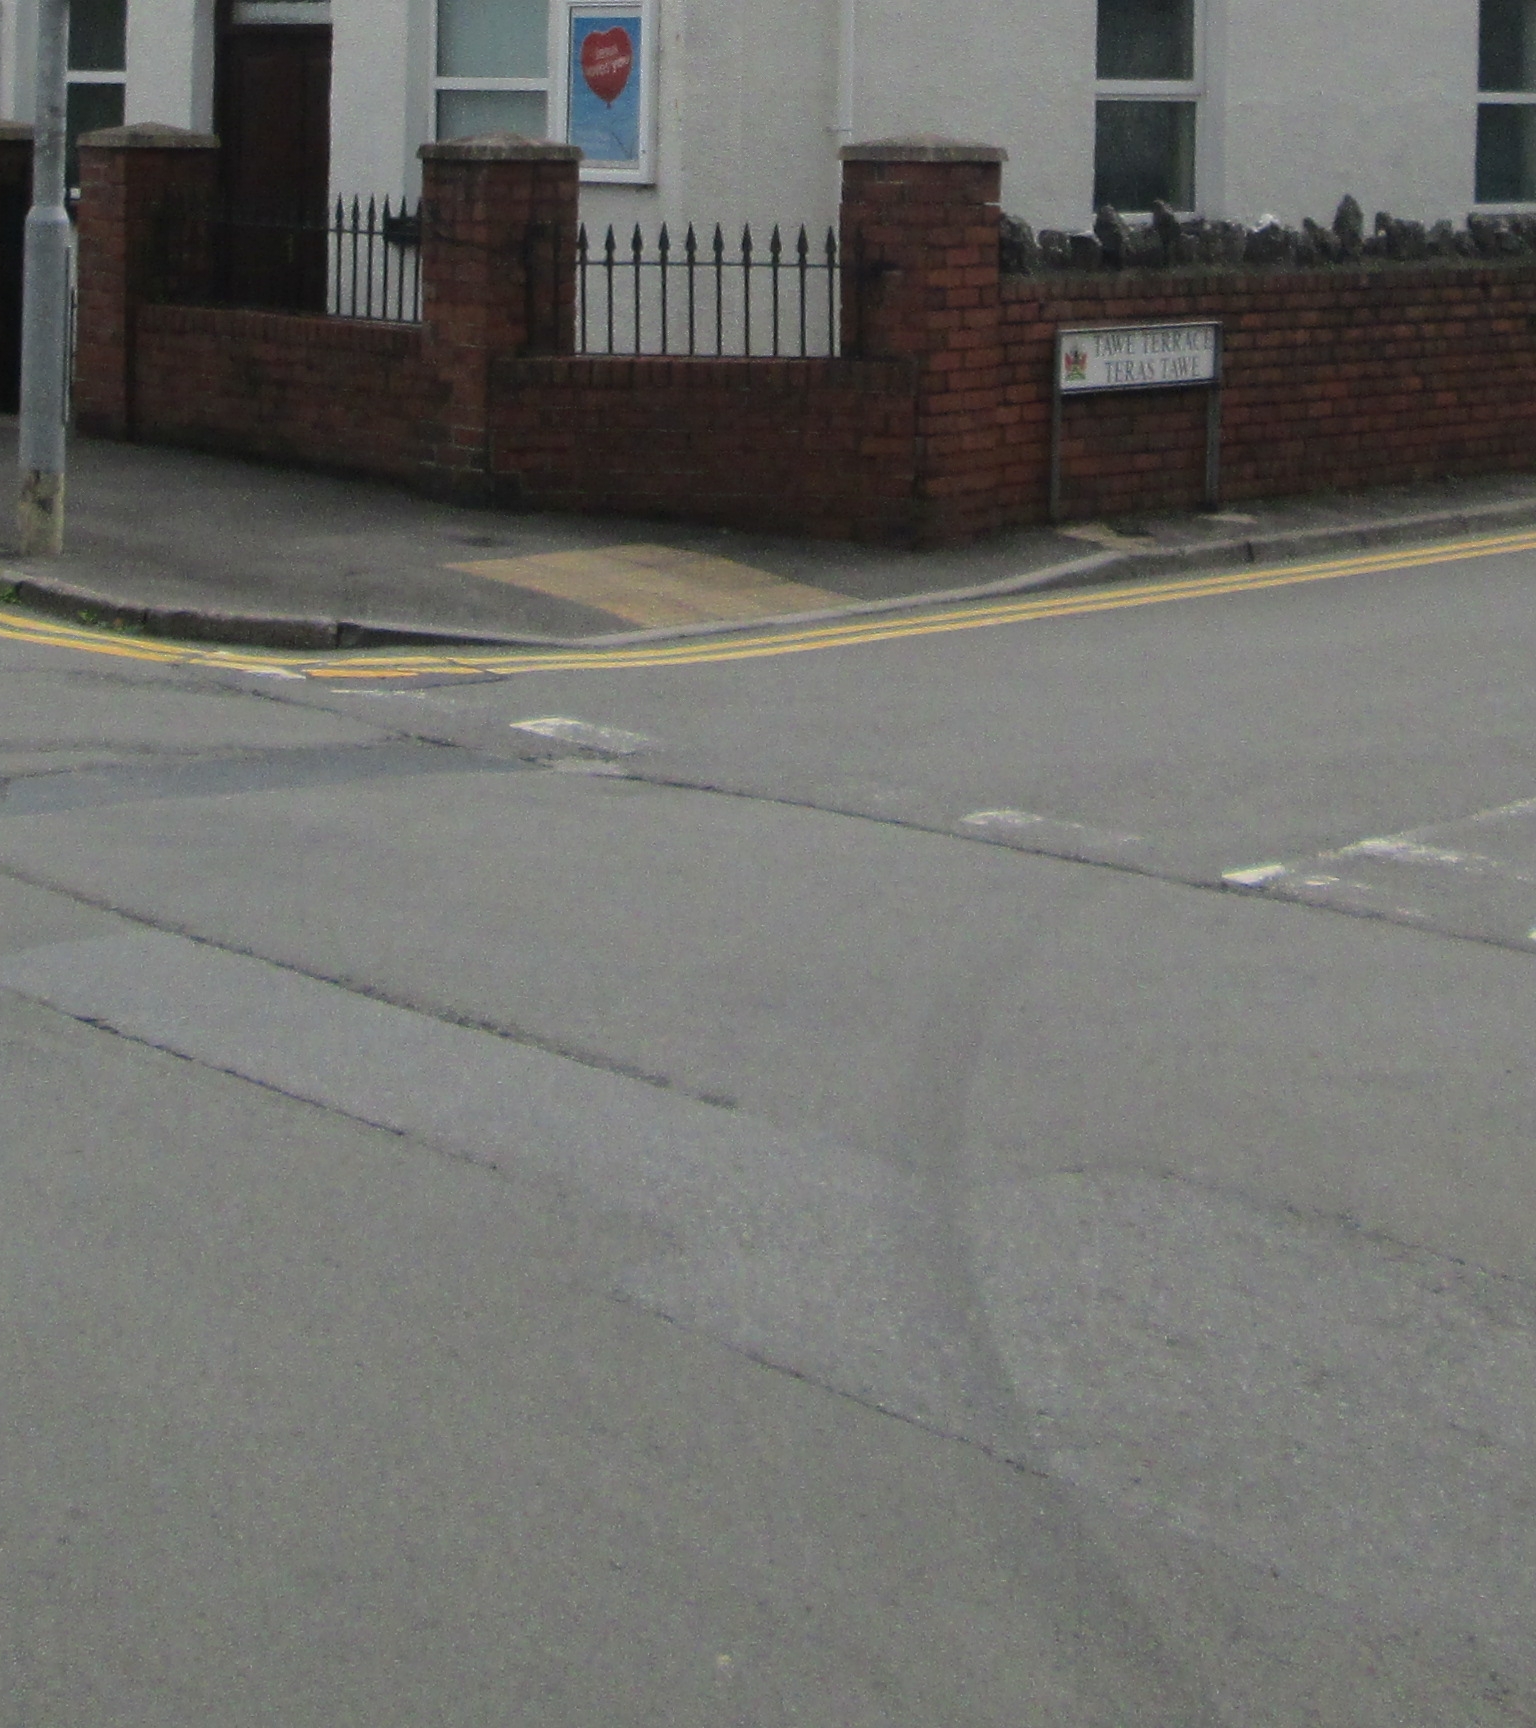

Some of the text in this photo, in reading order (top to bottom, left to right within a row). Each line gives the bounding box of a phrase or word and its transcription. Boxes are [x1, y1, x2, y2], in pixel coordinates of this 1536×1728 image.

[1093, 327, 1214, 358] TAWE TERRACE
[1104, 356, 1200, 383] TERAS TAWE
